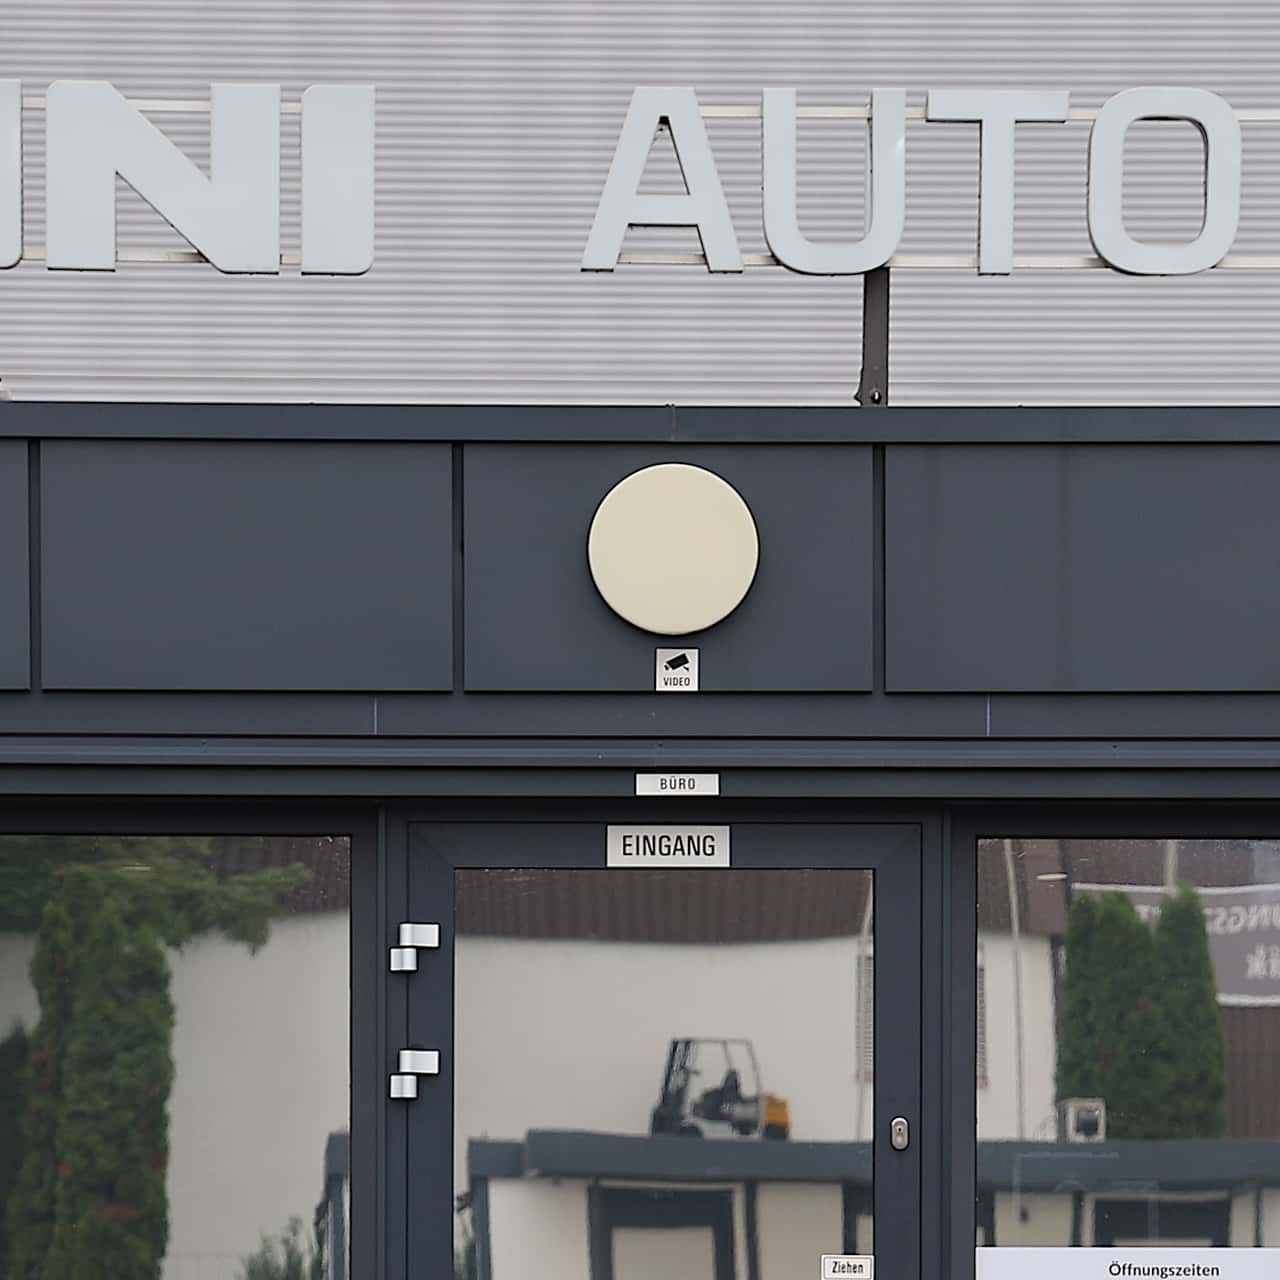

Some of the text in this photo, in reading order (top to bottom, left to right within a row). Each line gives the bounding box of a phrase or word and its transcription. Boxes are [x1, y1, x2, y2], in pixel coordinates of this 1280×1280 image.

[580, 86, 1243, 277] AUTO
[663, 677, 691, 687] VIDEO
[659, 776, 696, 790] BÜRO
[622, 834, 716, 857] EINGANG
[831, 1260, 864, 1274] Ziehen
[1108, 1260, 1221, 1279] Öffnungszeiten
